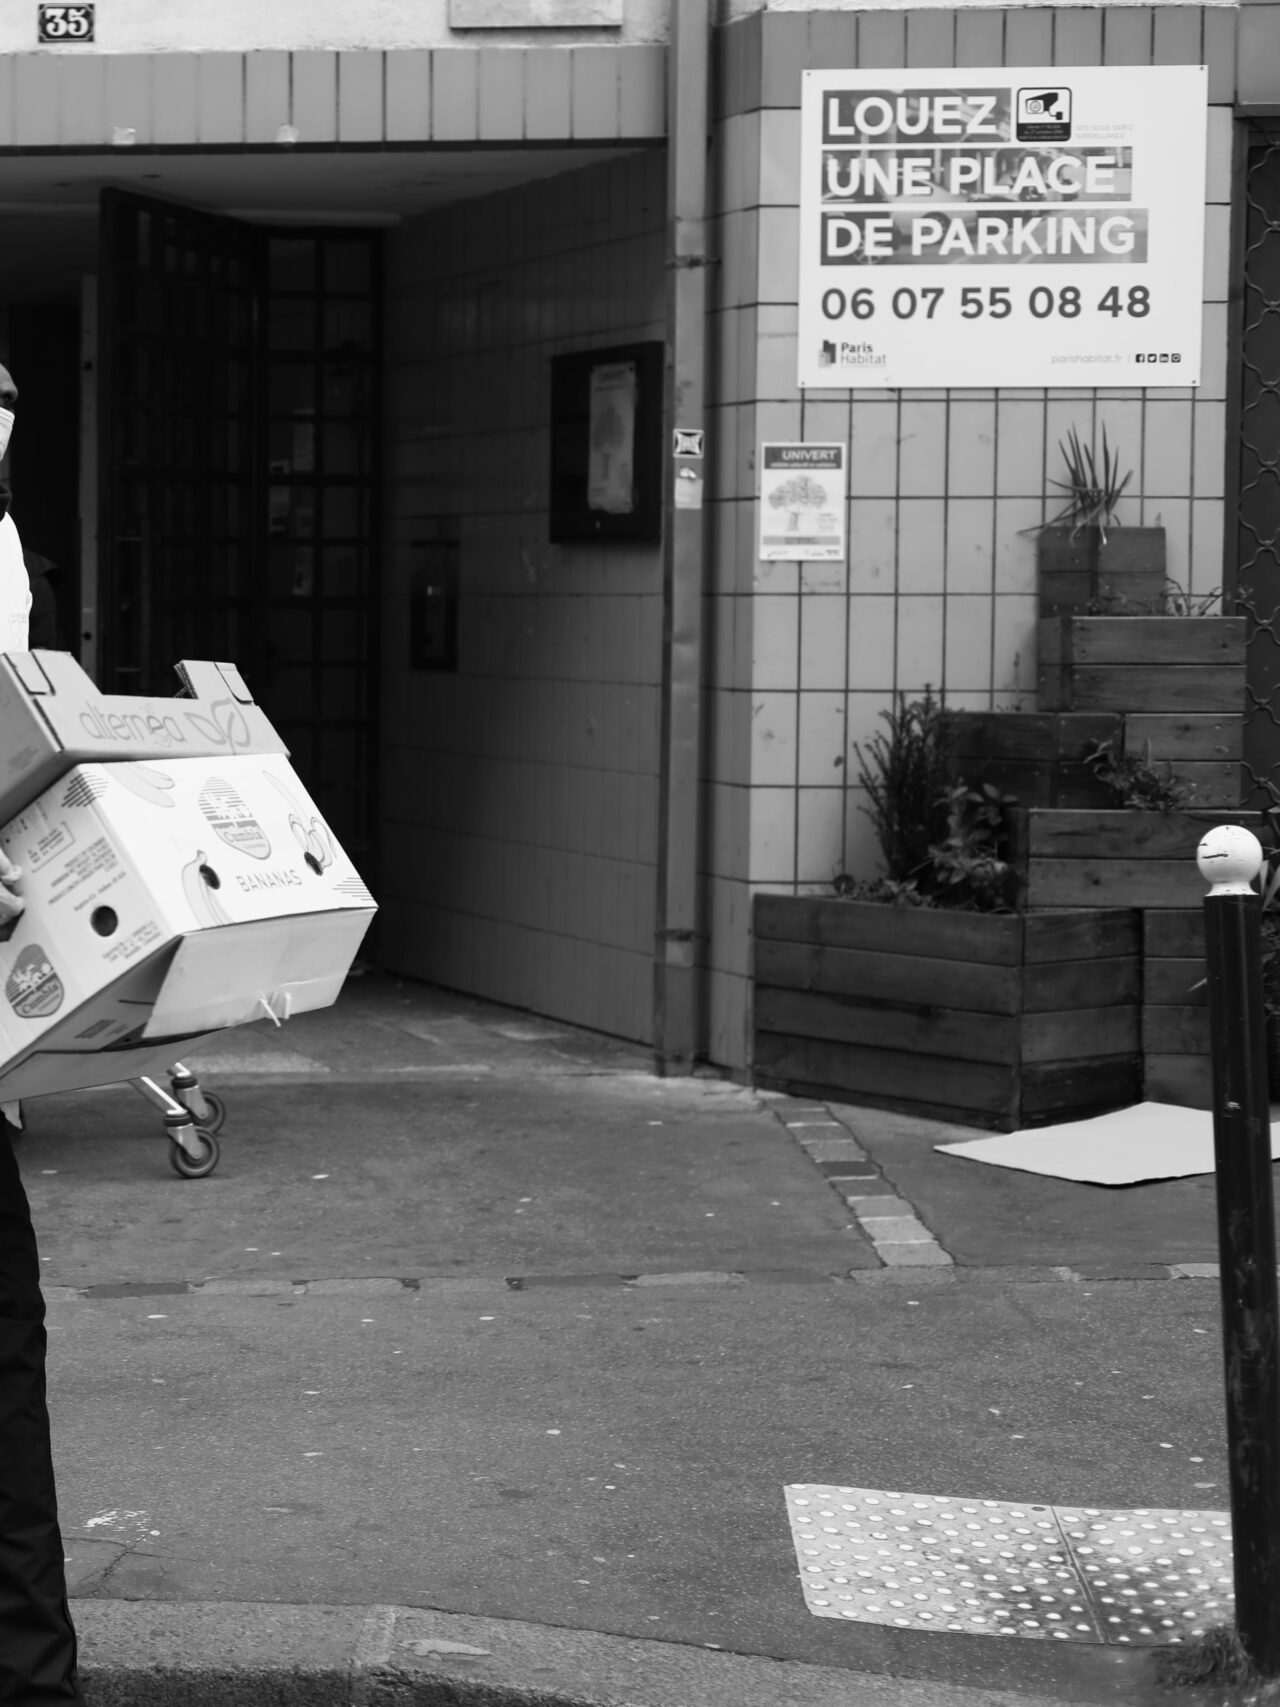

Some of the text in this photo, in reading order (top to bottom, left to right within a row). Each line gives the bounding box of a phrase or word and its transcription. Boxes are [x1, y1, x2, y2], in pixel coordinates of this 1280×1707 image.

[45, 7, 89, 37] 35
[827, 95, 998, 136] LOUEZ
[826, 155, 1115, 196] UNE PLACE
[826, 216, 1136, 257] DE PARKING
[821, 285, 1151, 320] 06 07 55 08 48
[841, 342, 873, 353] Paris
[841, 354, 887, 364] Habitat
[782, 449, 838, 462] UNIVERT
[236, 870, 303, 893] BANANAS
[22, 983, 60, 1015] Cumbia
